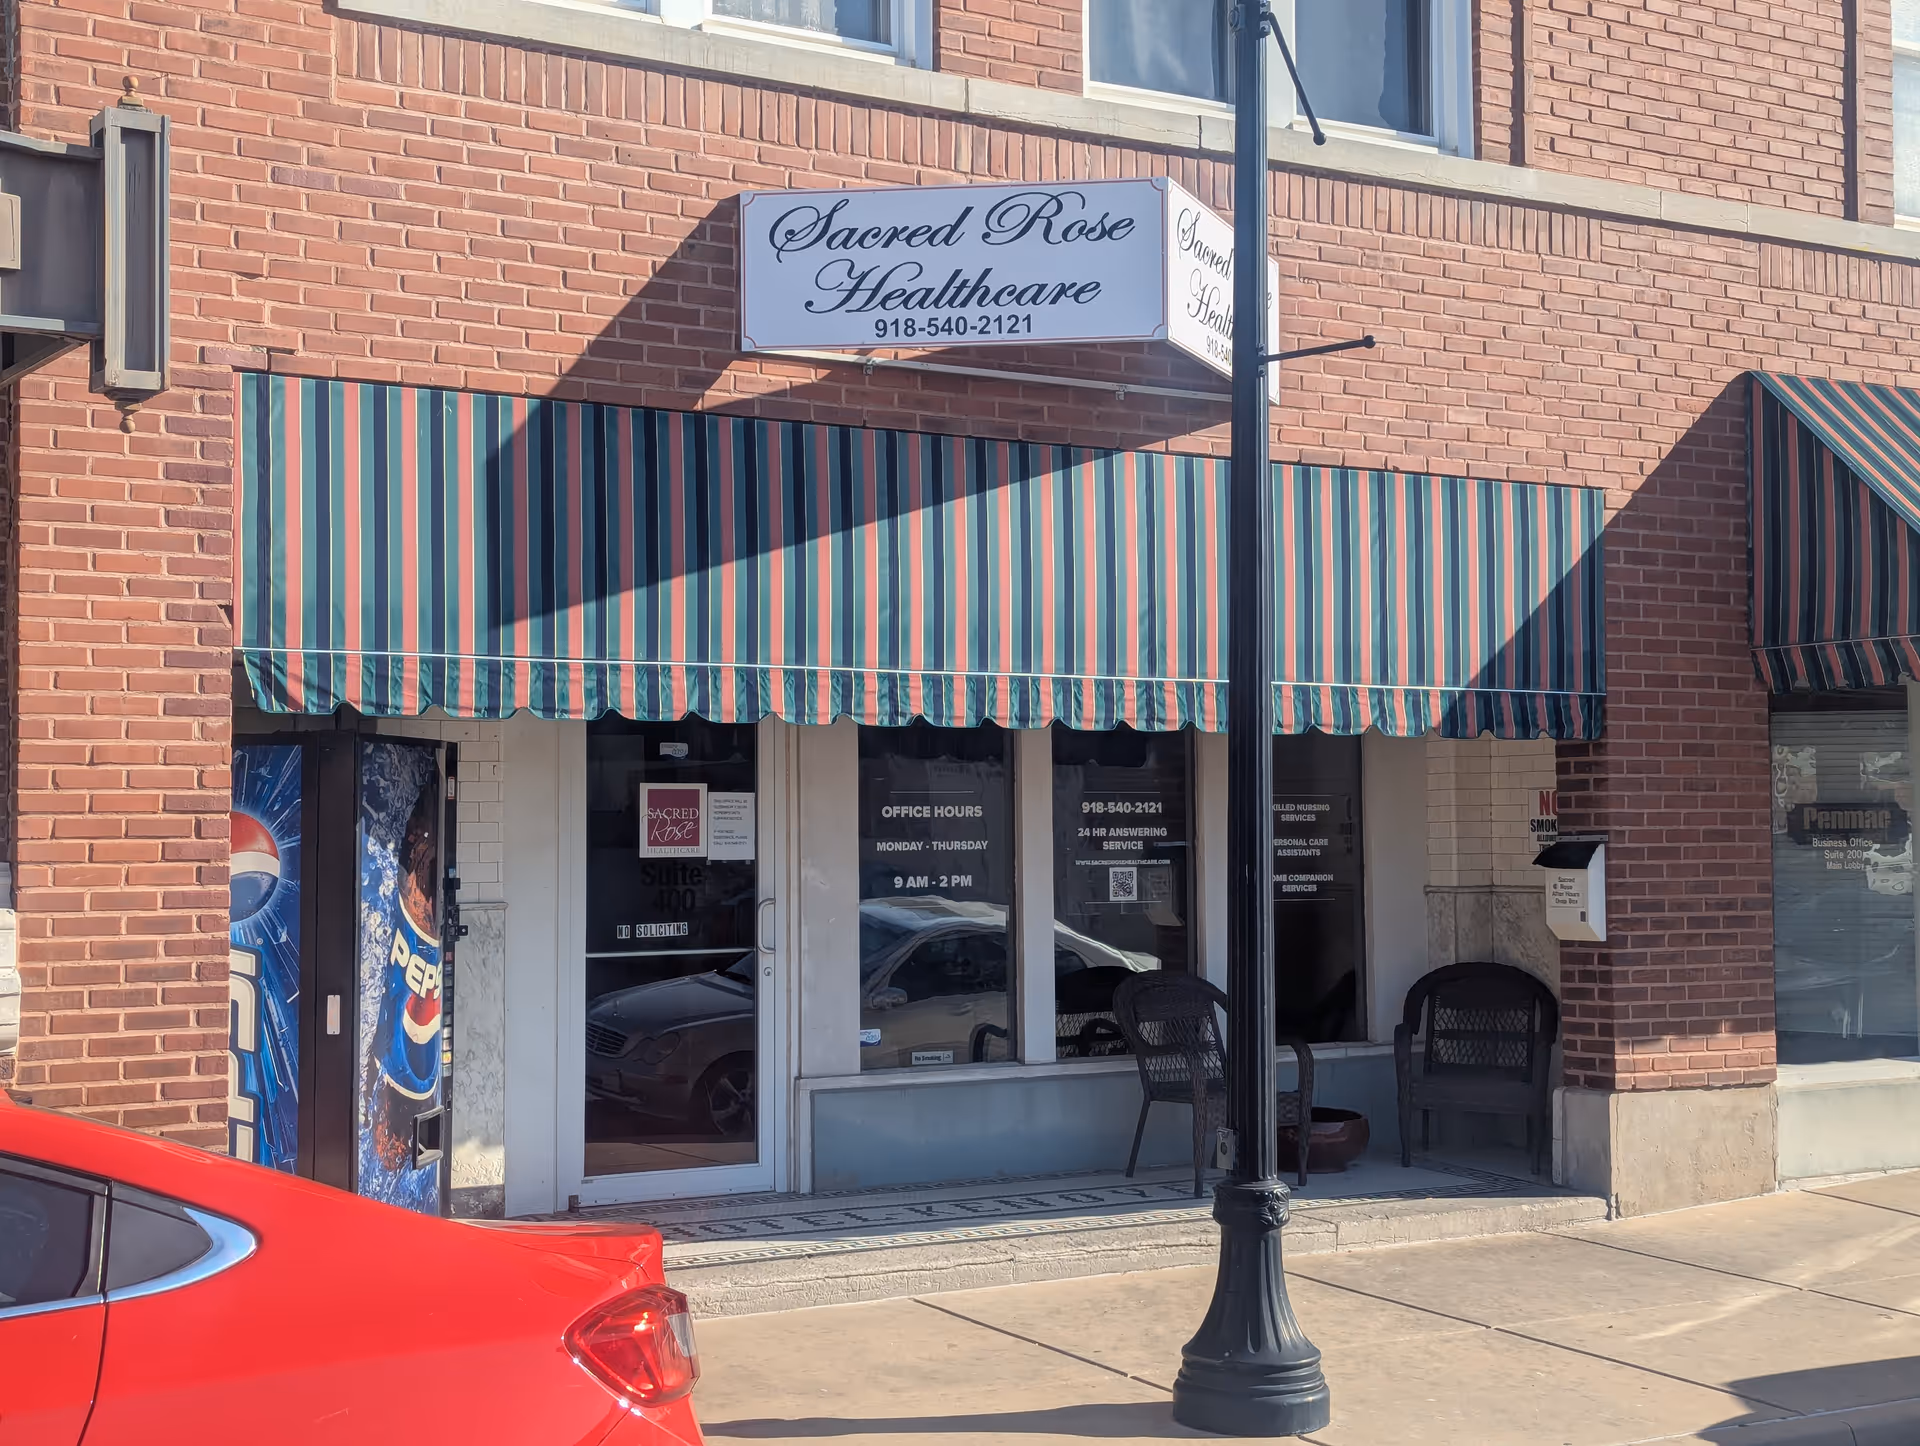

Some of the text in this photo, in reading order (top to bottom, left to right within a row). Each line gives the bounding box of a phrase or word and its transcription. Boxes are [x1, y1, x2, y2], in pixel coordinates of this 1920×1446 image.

[769, 191, 1136, 263] Sacred Rose
[1177, 207, 1234, 281] Sacred
[804, 258, 1102, 315] Healthcare
[1187, 268, 1233, 340] Healt
[874, 314, 1033, 339] 918-540-2121
[1206, 335, 1232, 366] 918-540
[647, 807, 699, 819] SACRED
[881, 805, 983, 818] OFFICE HOURS
[1081, 802, 1162, 814] 918-540-2121
[1272, 803, 1331, 812] KILLED NURSING
[1280, 814, 1316, 822] SERVICES
[643, 812, 698, 843] Rose
[1530, 818, 1557, 832] SMOK
[1077, 827, 1168, 837] 24 HR ANSWERING
[876, 841, 924, 851] MONDAY
[931, 840, 989, 851] THURSDAY
[1102, 840, 1144, 850] SERVICE
[1308, 838, 1329, 846] CARE
[1812, 837, 1873, 847] Business Office
[1277, 848, 1321, 857] ASSISTANTS
[1823, 849, 1862, 859] Suite 200
[1826, 861, 1865, 870] Main Lobby
[641, 862, 703, 886] Suite
[1272, 874, 1334, 882] OME COMPANION
[893, 876, 903, 889] 9
[905, 876, 929, 888] AM
[939, 876, 949, 888] 2
[951, 875, 972, 887] PM
[1282, 884, 1318, 892] SERVICES
[617, 922, 688, 938] NO SOLICITING
[390, 928, 442, 1000] PEPS
[906, 1182, 1209, 1217] KENOYE
